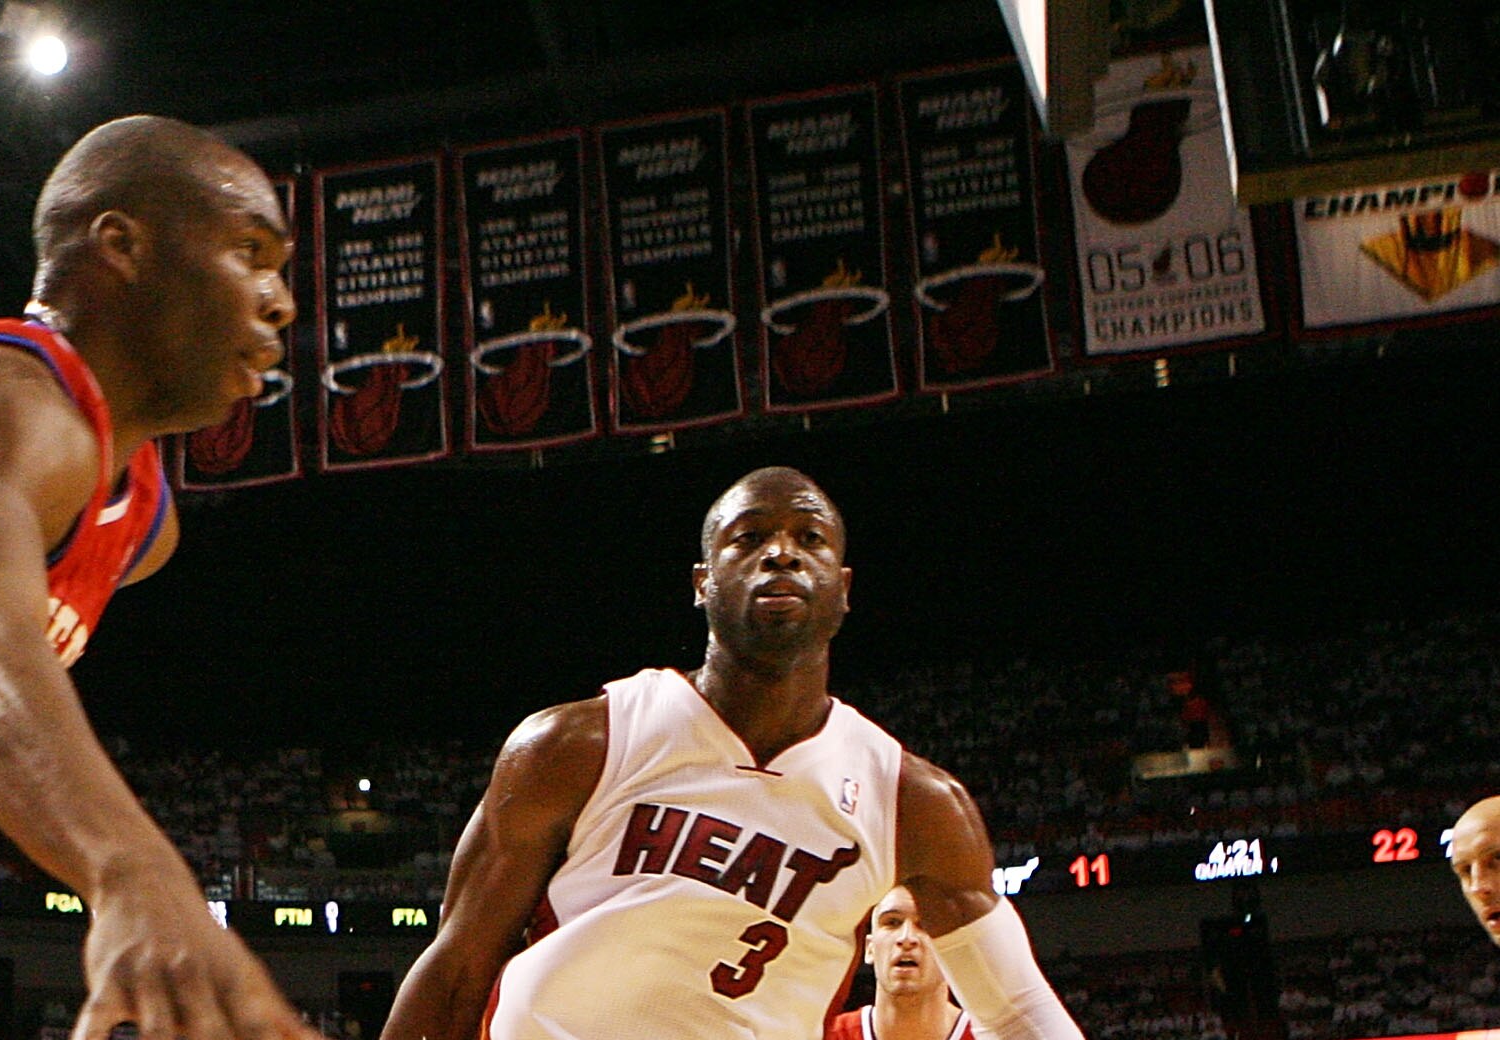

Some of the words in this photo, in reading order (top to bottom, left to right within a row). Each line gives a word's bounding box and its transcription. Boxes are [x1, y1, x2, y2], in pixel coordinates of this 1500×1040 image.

[476, 160, 557, 187] MIAMI
[492, 174, 563, 203] HEAT
[335, 182, 418, 210] MIAMI
[352, 198, 420, 225] HEAT
[1087, 244, 1145, 292] 05
[1184, 231, 1244, 279] 06
[336, 266, 424, 292] DIVISION
[336, 283, 424, 308] CHAMPIONS
[1094, 299, 1254, 341] CHAMPIONS
[1208, 838, 1261, 866] 4:21
[1371, 828, 1420, 862] 22
[612, 802, 861, 923] HEAT
[1069, 854, 1110, 887] 11
[45, 892, 83, 913] FGA
[275, 907, 312, 926] FTM
[392, 907, 427, 926] FTA
[709, 920, 789, 1000] 3
